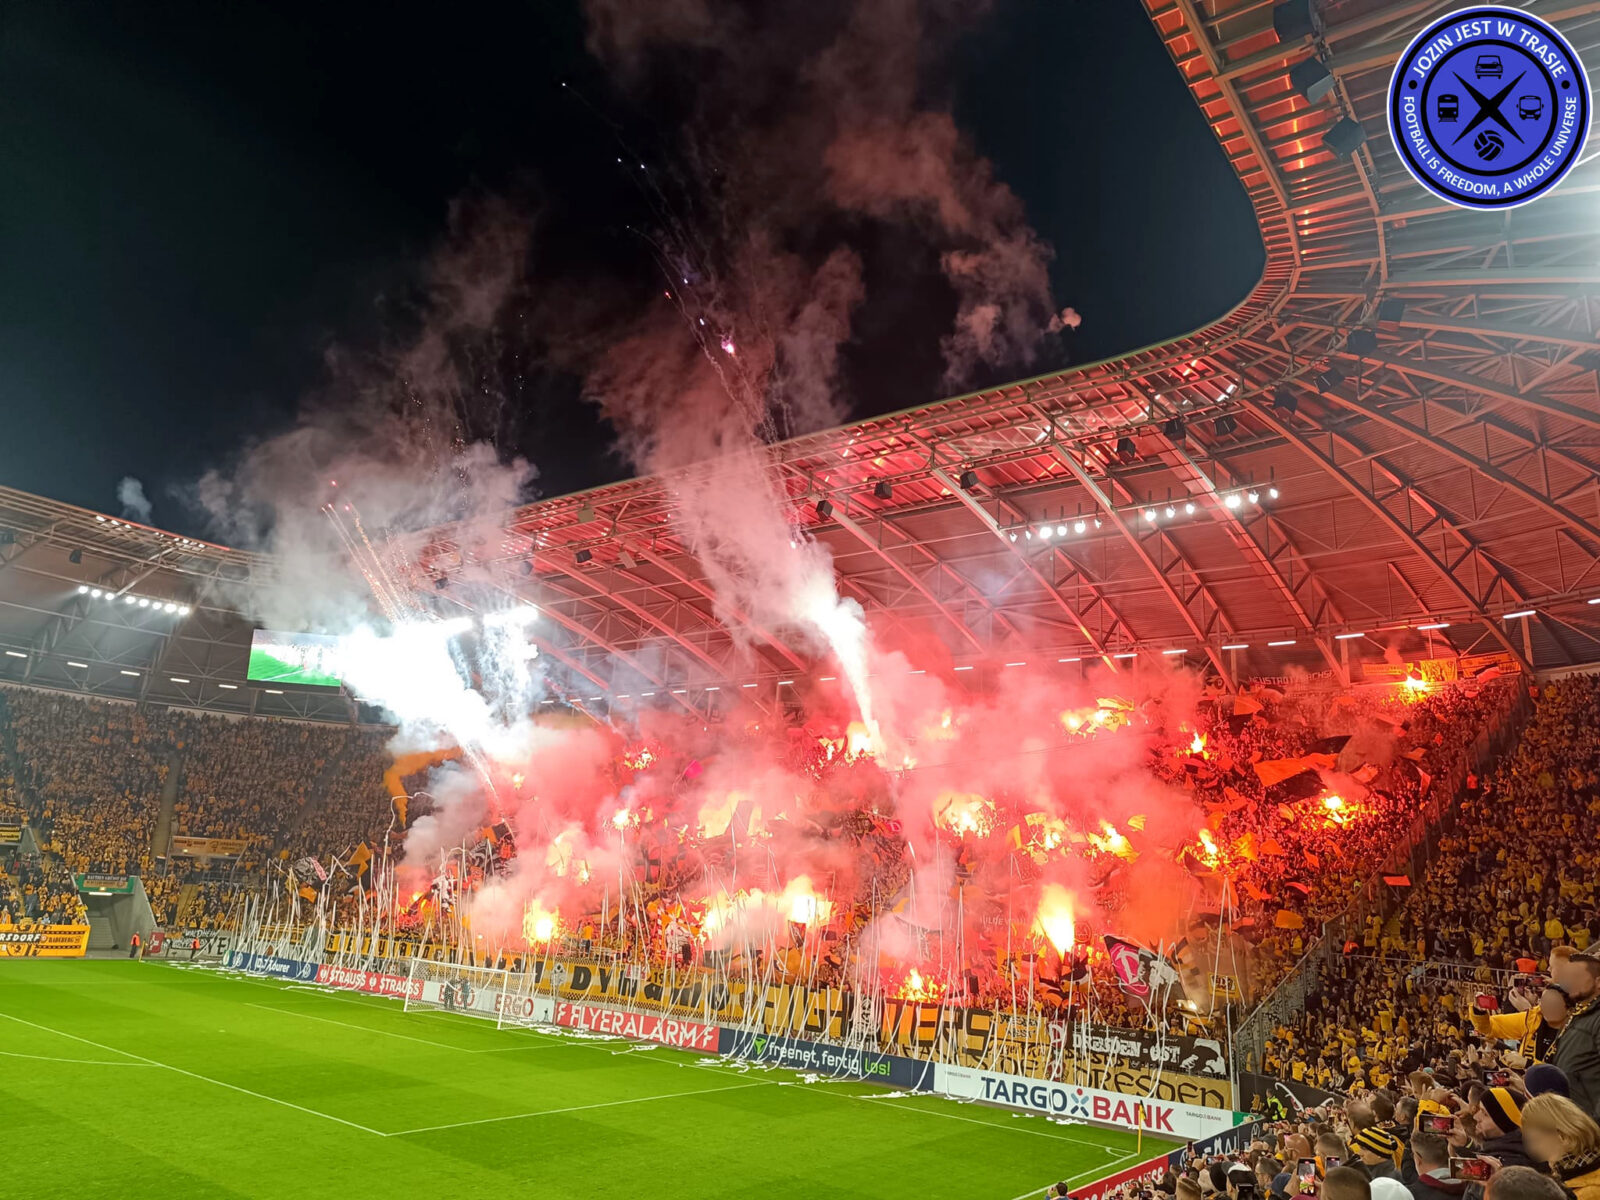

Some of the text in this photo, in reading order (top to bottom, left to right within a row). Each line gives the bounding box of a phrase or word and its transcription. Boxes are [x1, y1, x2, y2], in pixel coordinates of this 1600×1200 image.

[329, 965, 367, 988] STRAUSS
[379, 976, 421, 997] STRAUSS
[493, 993, 535, 1018] ERGO
[569, 1005, 697, 1049] FLYERALARM
[768, 1042, 820, 1067] freenet,
[865, 1057, 891, 1076] los!
